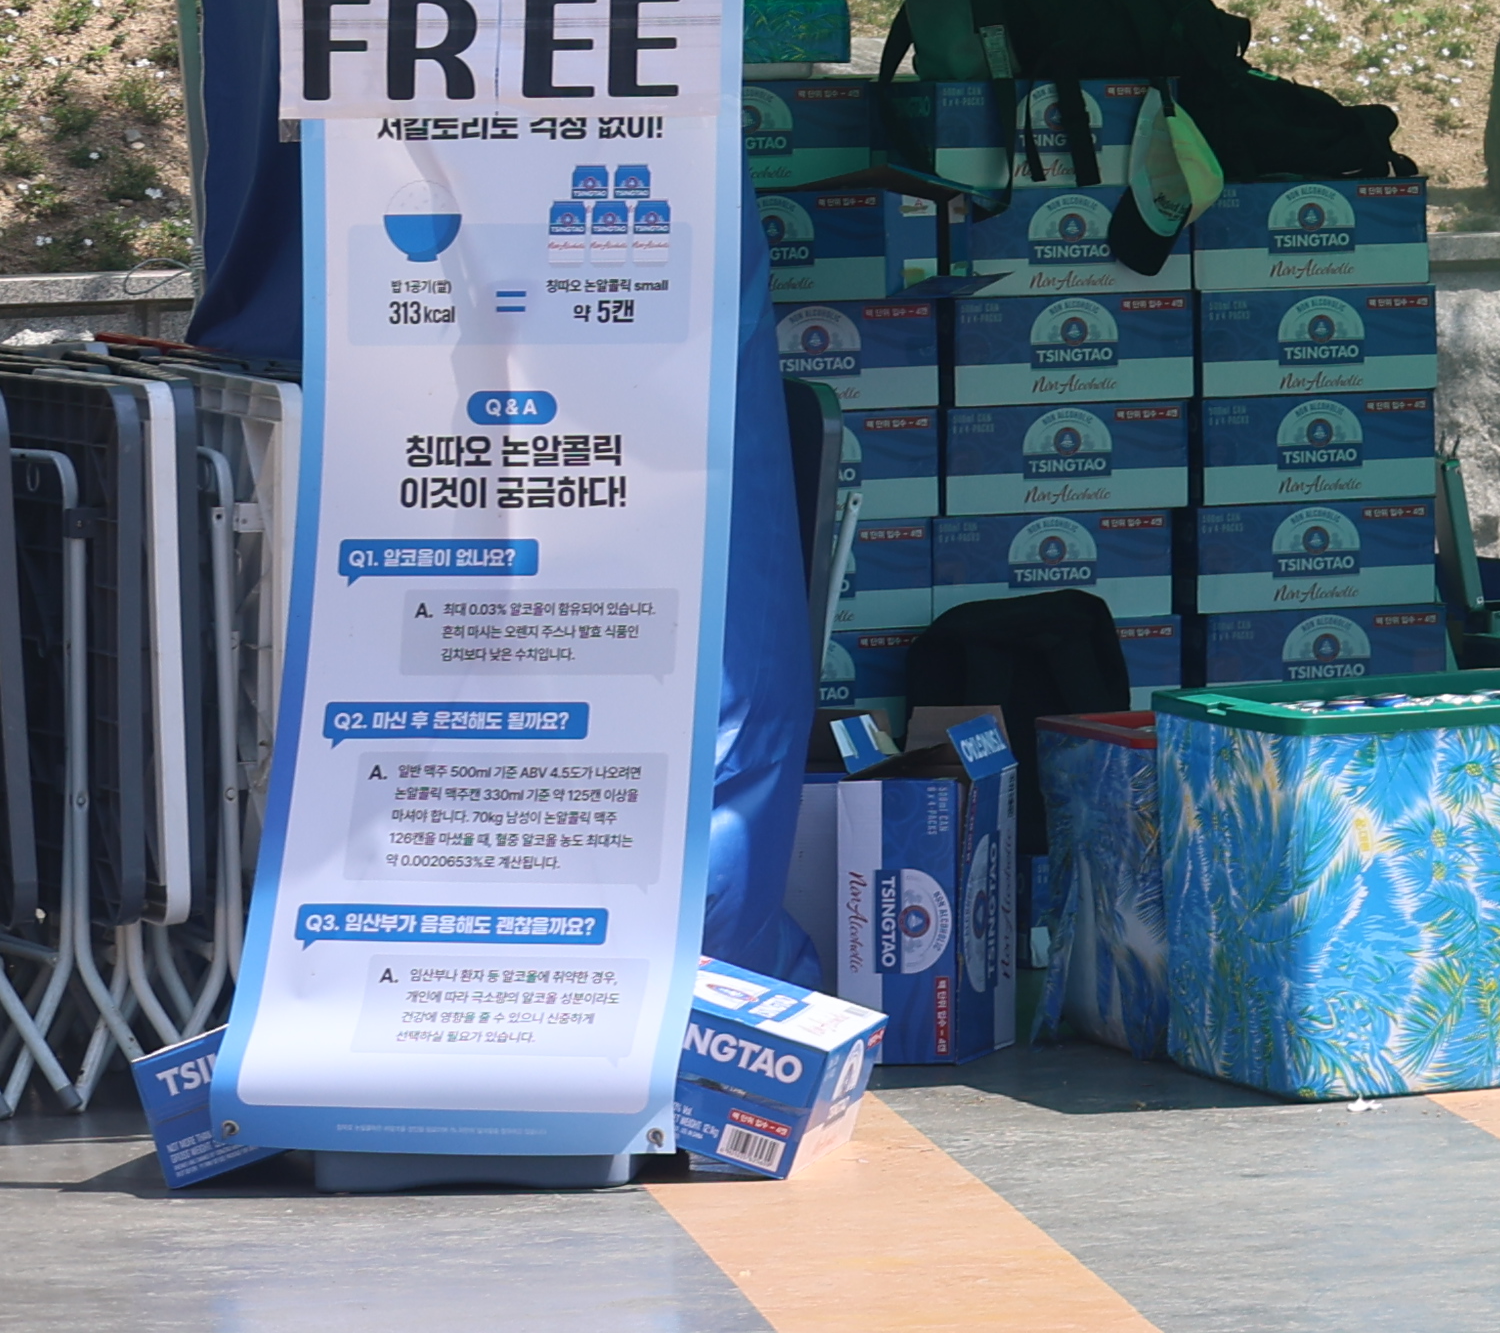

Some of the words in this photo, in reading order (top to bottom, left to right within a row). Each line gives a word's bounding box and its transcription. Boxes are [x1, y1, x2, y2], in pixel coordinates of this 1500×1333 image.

[1274, 231, 1350, 248] TSINGTAO
[1034, 244, 1110, 258] TSINGTAO
[546, 279, 582, 293] 칭따오
[584, 279, 631, 293] 논알콜릭
[634, 280, 669, 291] small
[574, 305, 591, 322] 약
[597, 300, 634, 323] 5캔
[1036, 347, 1113, 363] TSINGTAO
[1283, 342, 1359, 360] TSINGTAO
[406, 435, 492, 467] 칭따오
[501, 435, 621, 467] 논알콜릭
[1279, 446, 1357, 464] TSINGTAO
[1029, 455, 1106, 473] TSINGTAO
[401, 477, 486, 508] 이것이
[496, 476, 626, 509] 궁금하다!
[349, 550, 378, 568] Q1.
[384, 549, 451, 567] 알코올이
[456, 549, 516, 568] 없나요?
[1278, 554, 1354, 572] TSINGTAO
[1014, 566, 1091, 582] TSINGTAO
[415, 603, 433, 618] A.
[443, 603, 467, 616] 최대
[469, 604, 507, 615] 0.03%
[510, 602, 555, 616] 알코올이
[558, 602, 604, 616] 함유되어
[607, 602, 656, 616] 있습니다.
[442, 625, 465, 639] 흔히
[467, 625, 502, 639] 마시는
[504, 625, 539, 639] 오렌지
[541, 625, 576, 639] 주스나
[579, 625, 602, 639] 발효
[605, 625, 639, 638] 식품인
[441, 648, 487, 662] 김치보다
[489, 648, 512, 661] 낮은
[515, 647, 575, 661] 수치입니다.
[1285, 660, 1367, 679] TSINGTAO
[334, 713, 367, 731] Q2.
[372, 712, 407, 729] 마신
[410, 711, 429, 729] 후
[433, 711, 503, 730] 운전해도
[507, 712, 569, 730] 될까요?
[368, 765, 387, 780] A.
[398, 764, 422, 778] 일반
[424, 764, 447, 778] 맥주
[450, 766, 492, 778] 500ml
[493, 766, 518, 779] 기준
[519, 767, 548, 778] ABV
[549, 766, 593, 780] 4.5도가
[595, 766, 641, 780] 나오려면
[395, 787, 442, 800] 논알콜릭
[445, 787, 481, 801] 맥주캔
[483, 789, 524, 801] 330ml
[526, 788, 550, 802] 기준
[553, 789, 565, 802] 약
[567, 789, 602, 802] 125캔
[604, 789, 638, 802] 이상을
[391, 809, 428, 823] 마셔야
[431, 809, 469, 823] 합니다.
[472, 811, 504, 826] 70kg
[506, 810, 542, 824] 남성이
[544, 811, 591, 825] 논알콜릭
[594, 811, 617, 825] 맥주
[389, 832, 436, 845] 126캔을
[439, 832, 475, 846] 마셨을
[477, 833, 492, 848] 때,
[496, 833, 519, 847] 혈중
[522, 833, 557, 847] 알코올
[560, 834, 584, 847] 농도
[586, 834, 634, 848] 최대치는
[305, 914, 340, 932] Q3.
[345, 913, 417, 933] 임산부가
[420, 915, 491, 934] 음용해도
[496, 916, 595, 936] 괜찮을까요?
[880, 876, 897, 968] TSINGTAO
[380, 968, 398, 983] A.
